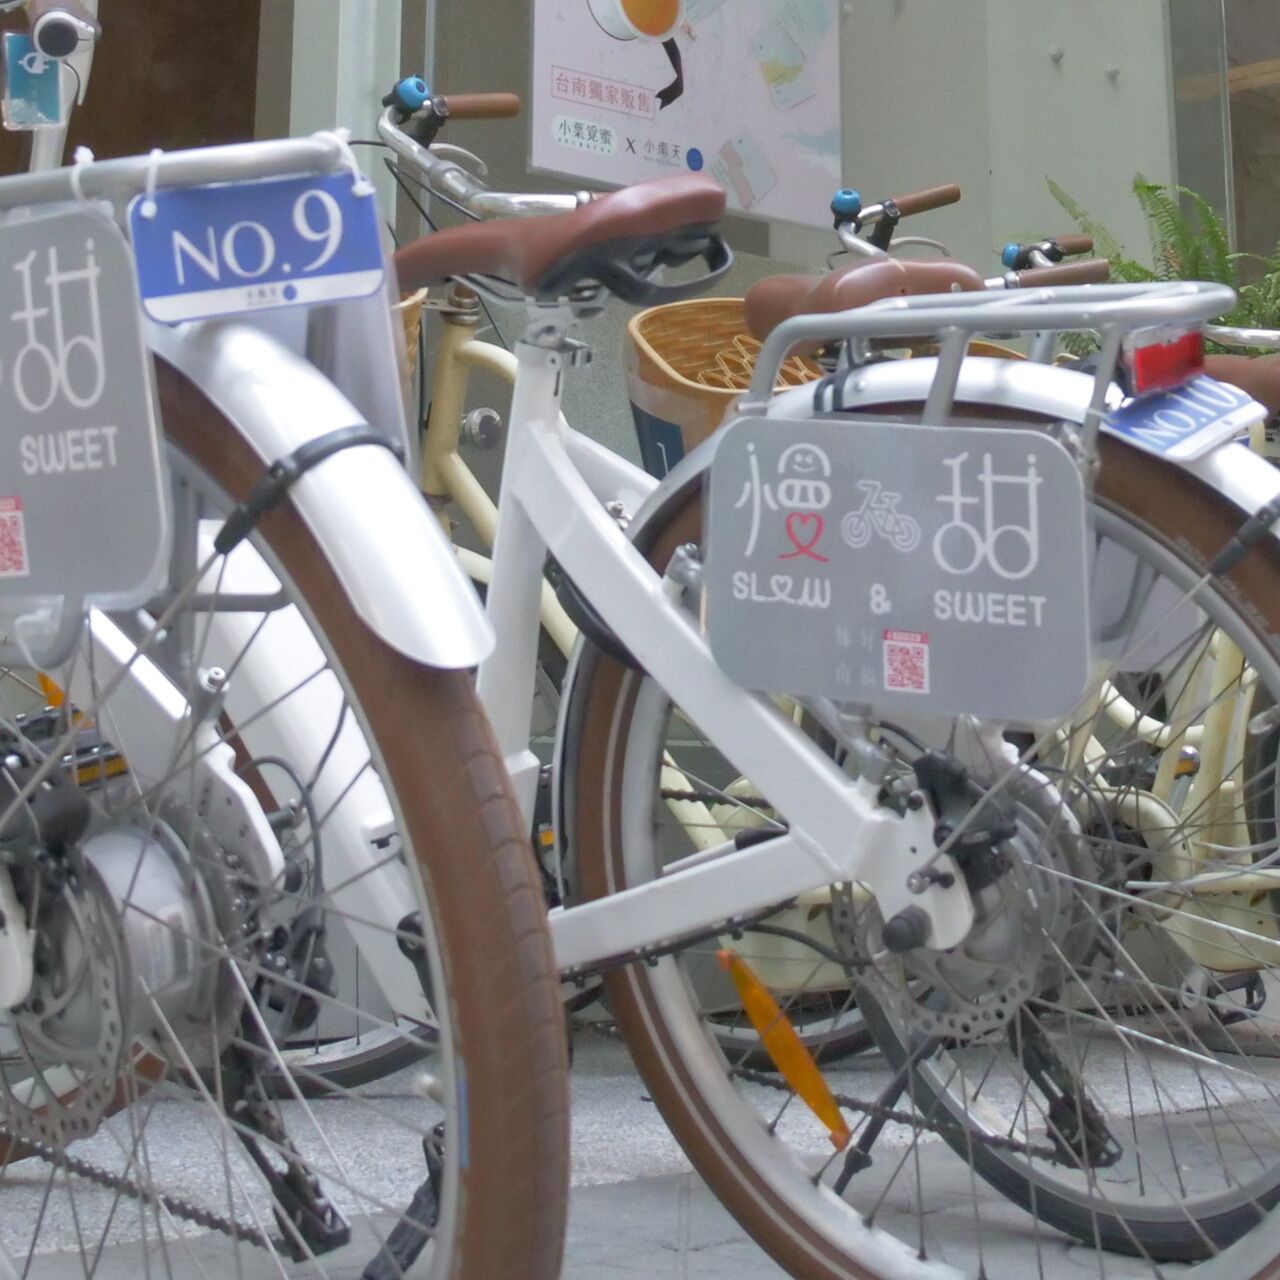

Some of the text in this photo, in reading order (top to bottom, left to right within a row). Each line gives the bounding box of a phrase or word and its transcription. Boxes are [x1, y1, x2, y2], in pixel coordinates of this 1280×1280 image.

[555, 72, 651, 114] 台南獨家販售
[643, 138, 681, 161] 小南天
[171, 188, 344, 287] NO.9
[1129, 378, 1238, 447] NO.10
[20, 426, 119, 476] SWEET
[870, 584, 892, 615] &
[933, 588, 1047, 627] SWEET
